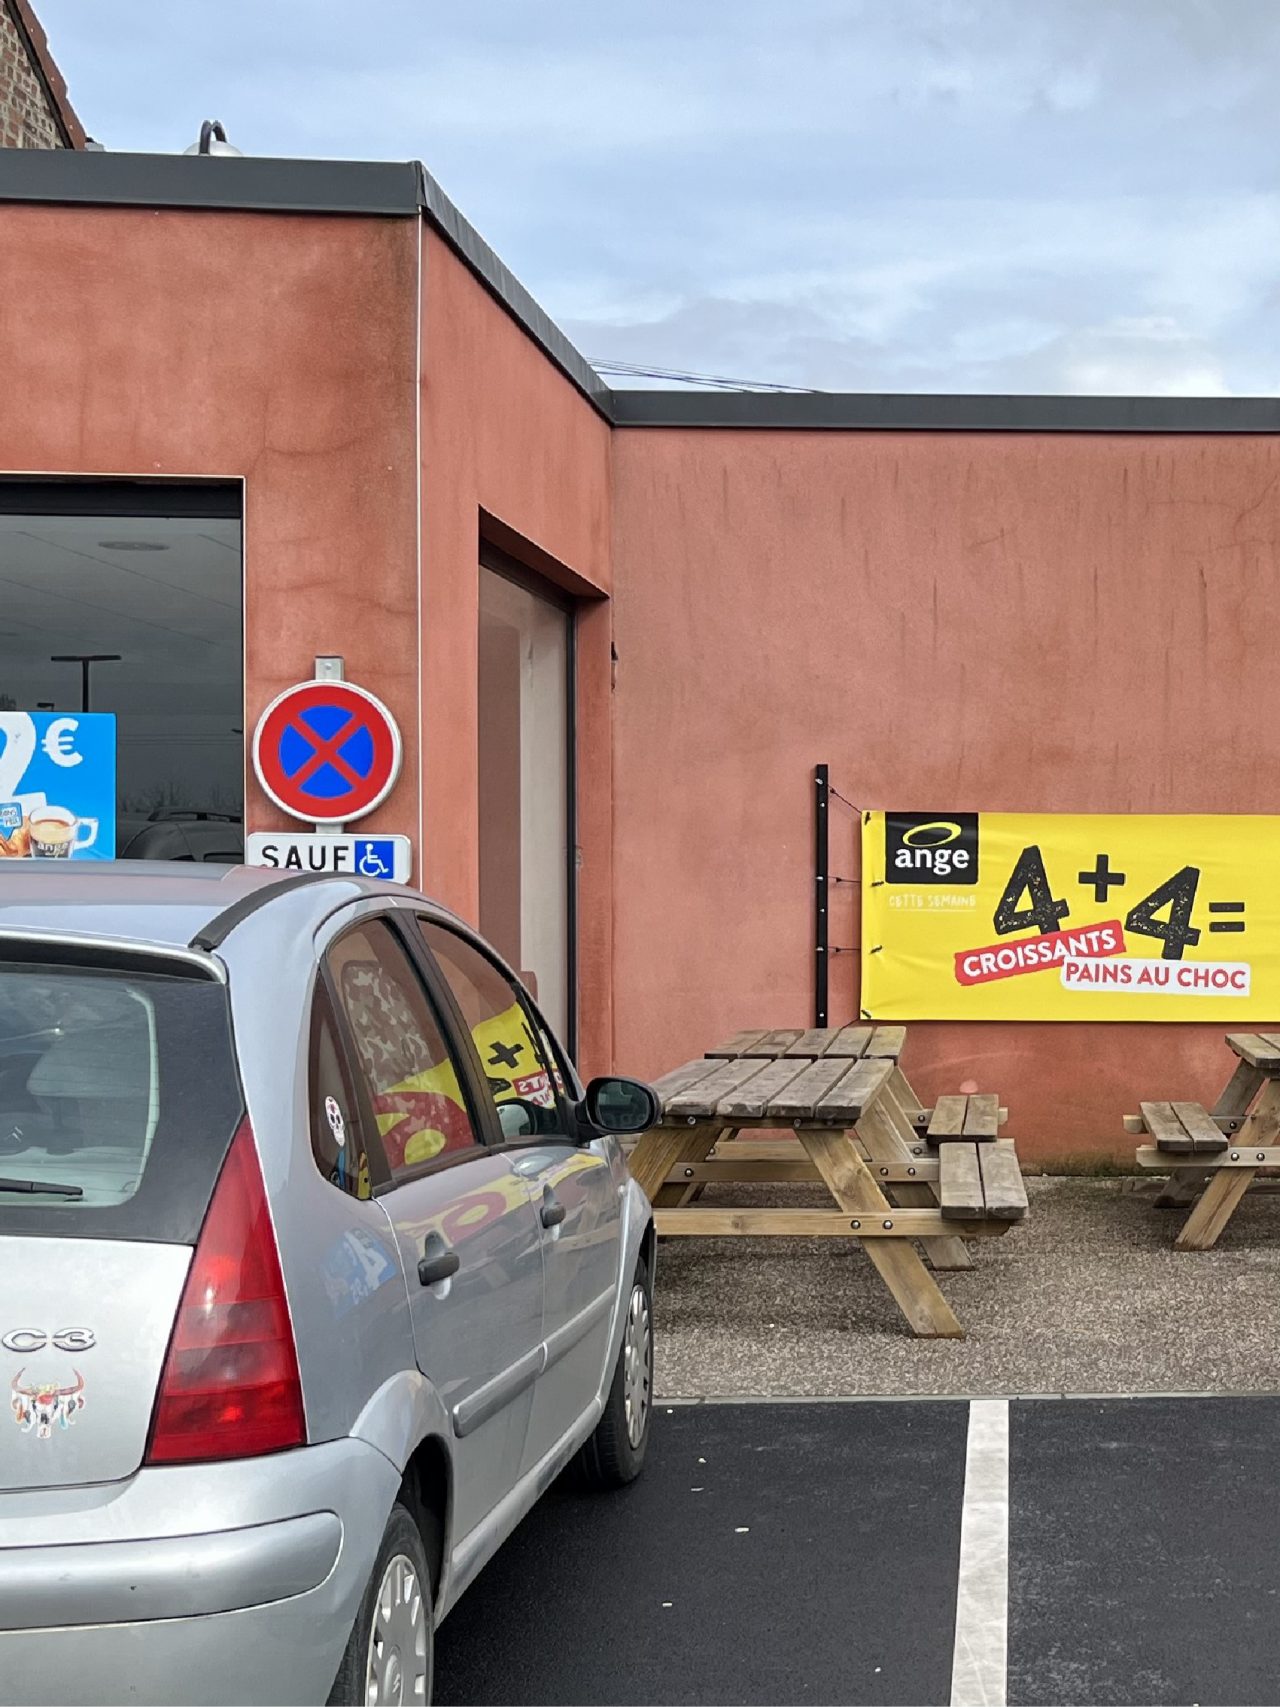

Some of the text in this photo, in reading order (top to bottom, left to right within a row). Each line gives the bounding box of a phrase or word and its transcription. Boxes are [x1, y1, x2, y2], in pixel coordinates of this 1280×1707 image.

[262, 845, 349, 871] SAUF
[894, 848, 970, 875] ange
[889, 894, 976, 907] CETTE SEMAINE
[963, 929, 1116, 977] CROISSANTS
[1066, 963, 1246, 989] PAINS AU CHOC
[2, 1327, 96, 1353] C3
